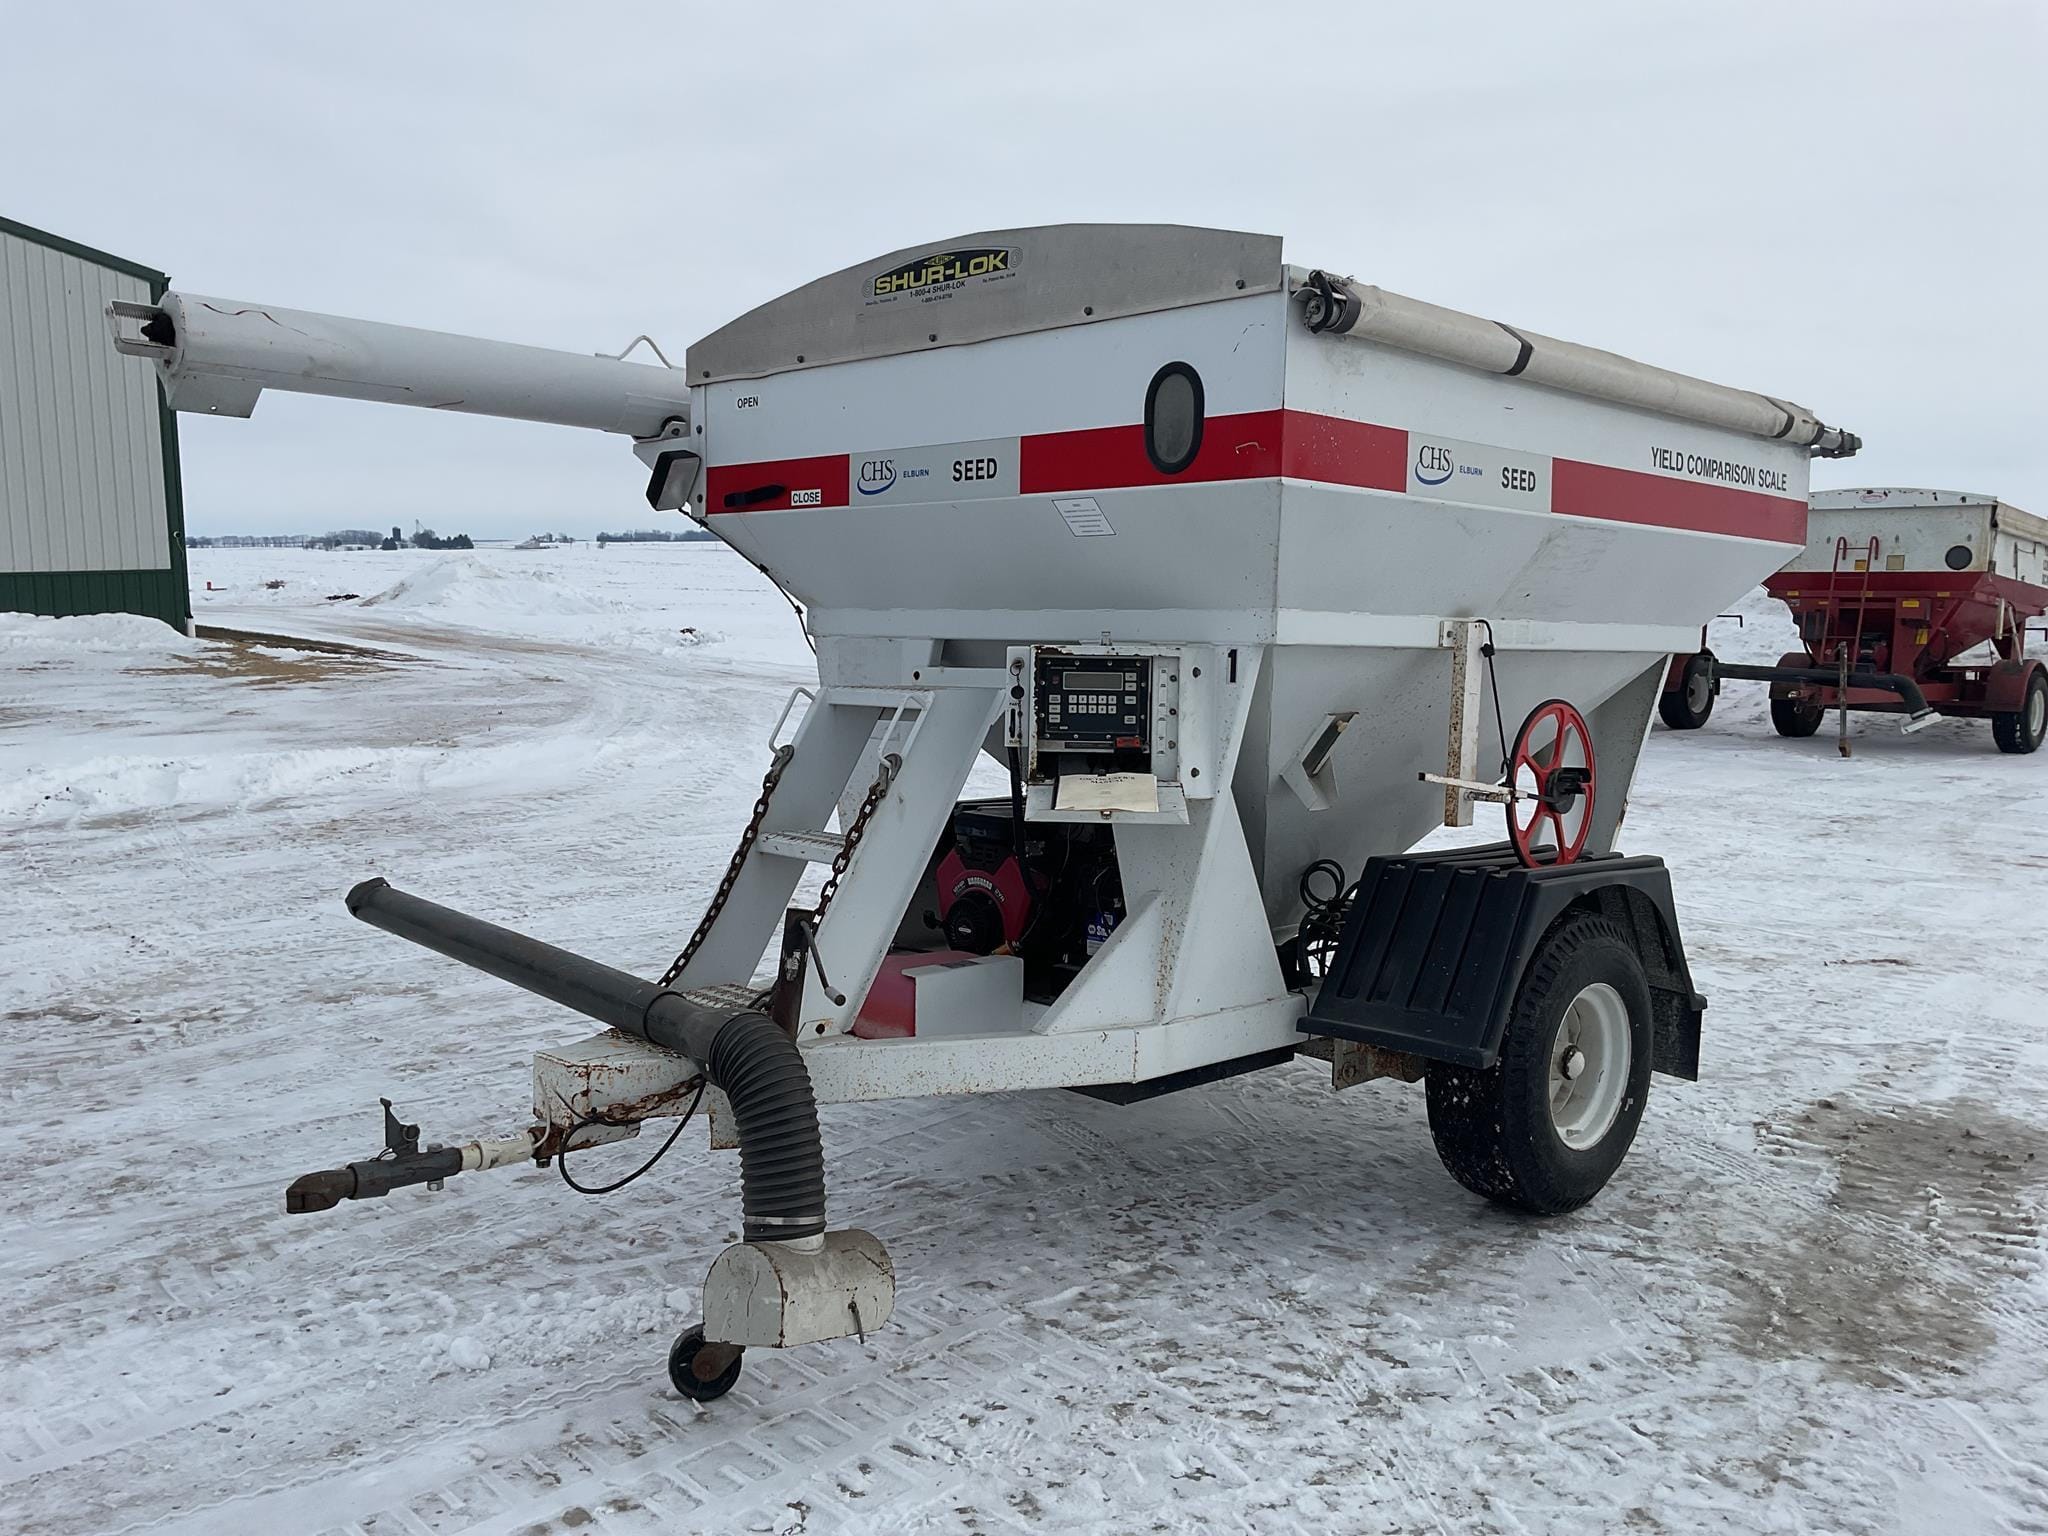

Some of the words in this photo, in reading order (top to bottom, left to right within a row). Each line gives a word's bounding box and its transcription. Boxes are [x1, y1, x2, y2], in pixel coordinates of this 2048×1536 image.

[875, 251, 1007, 295] SHUR-LOK
[910, 288, 931, 298] 1-800-4
[932, 280, 966, 294] SHUR-LOK
[737, 396, 759, 409] OPEN
[861, 459, 893, 482] CHS
[903, 469, 930, 479] ELBURN
[952, 457, 998, 482] SEED
[1419, 445, 1451, 472] CHS
[1459, 465, 1483, 476] ELBURN
[1501, 467, 1537, 492] SEED
[1651, 446, 1684, 472] YIELD
[1686, 454, 1756, 486] COMPARISON
[1758, 469, 1787, 491] SCALE
[792, 491, 820, 504] CLOSE
